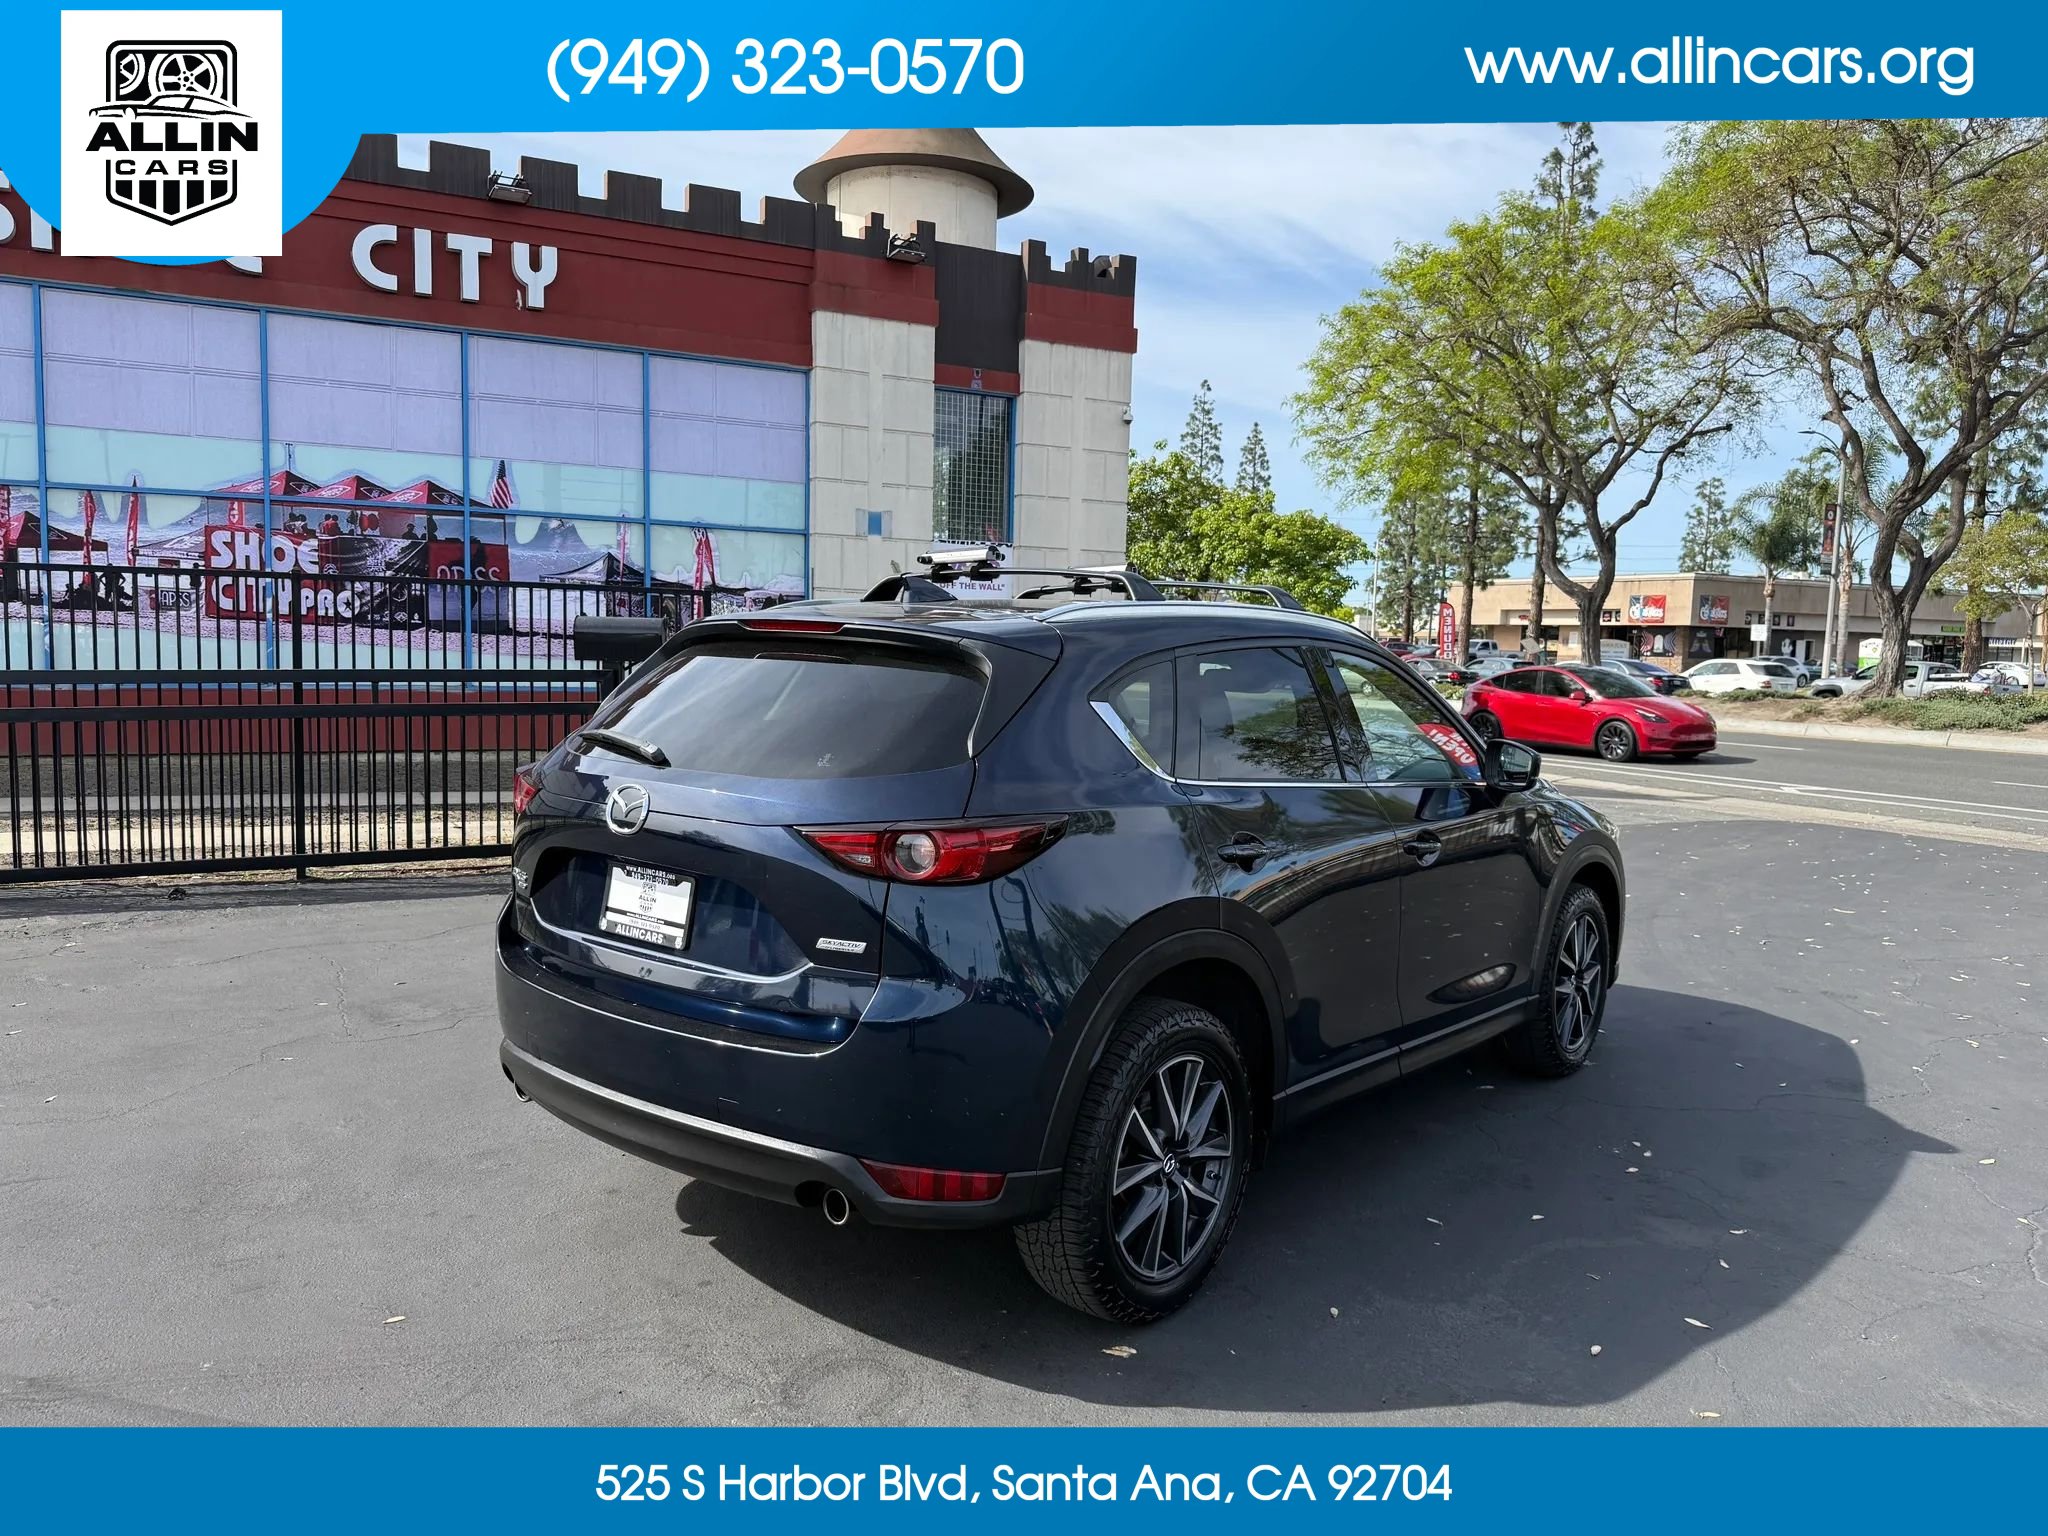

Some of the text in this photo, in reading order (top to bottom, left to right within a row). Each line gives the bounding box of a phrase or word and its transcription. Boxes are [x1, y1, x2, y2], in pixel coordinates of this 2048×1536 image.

[351, 224, 559, 310] CITY
[210, 530, 320, 575] SHOE
[211, 577, 293, 615] CITY
[959, 582, 977, 590] THE
[615, 923, 664, 944] ALLINCARS
